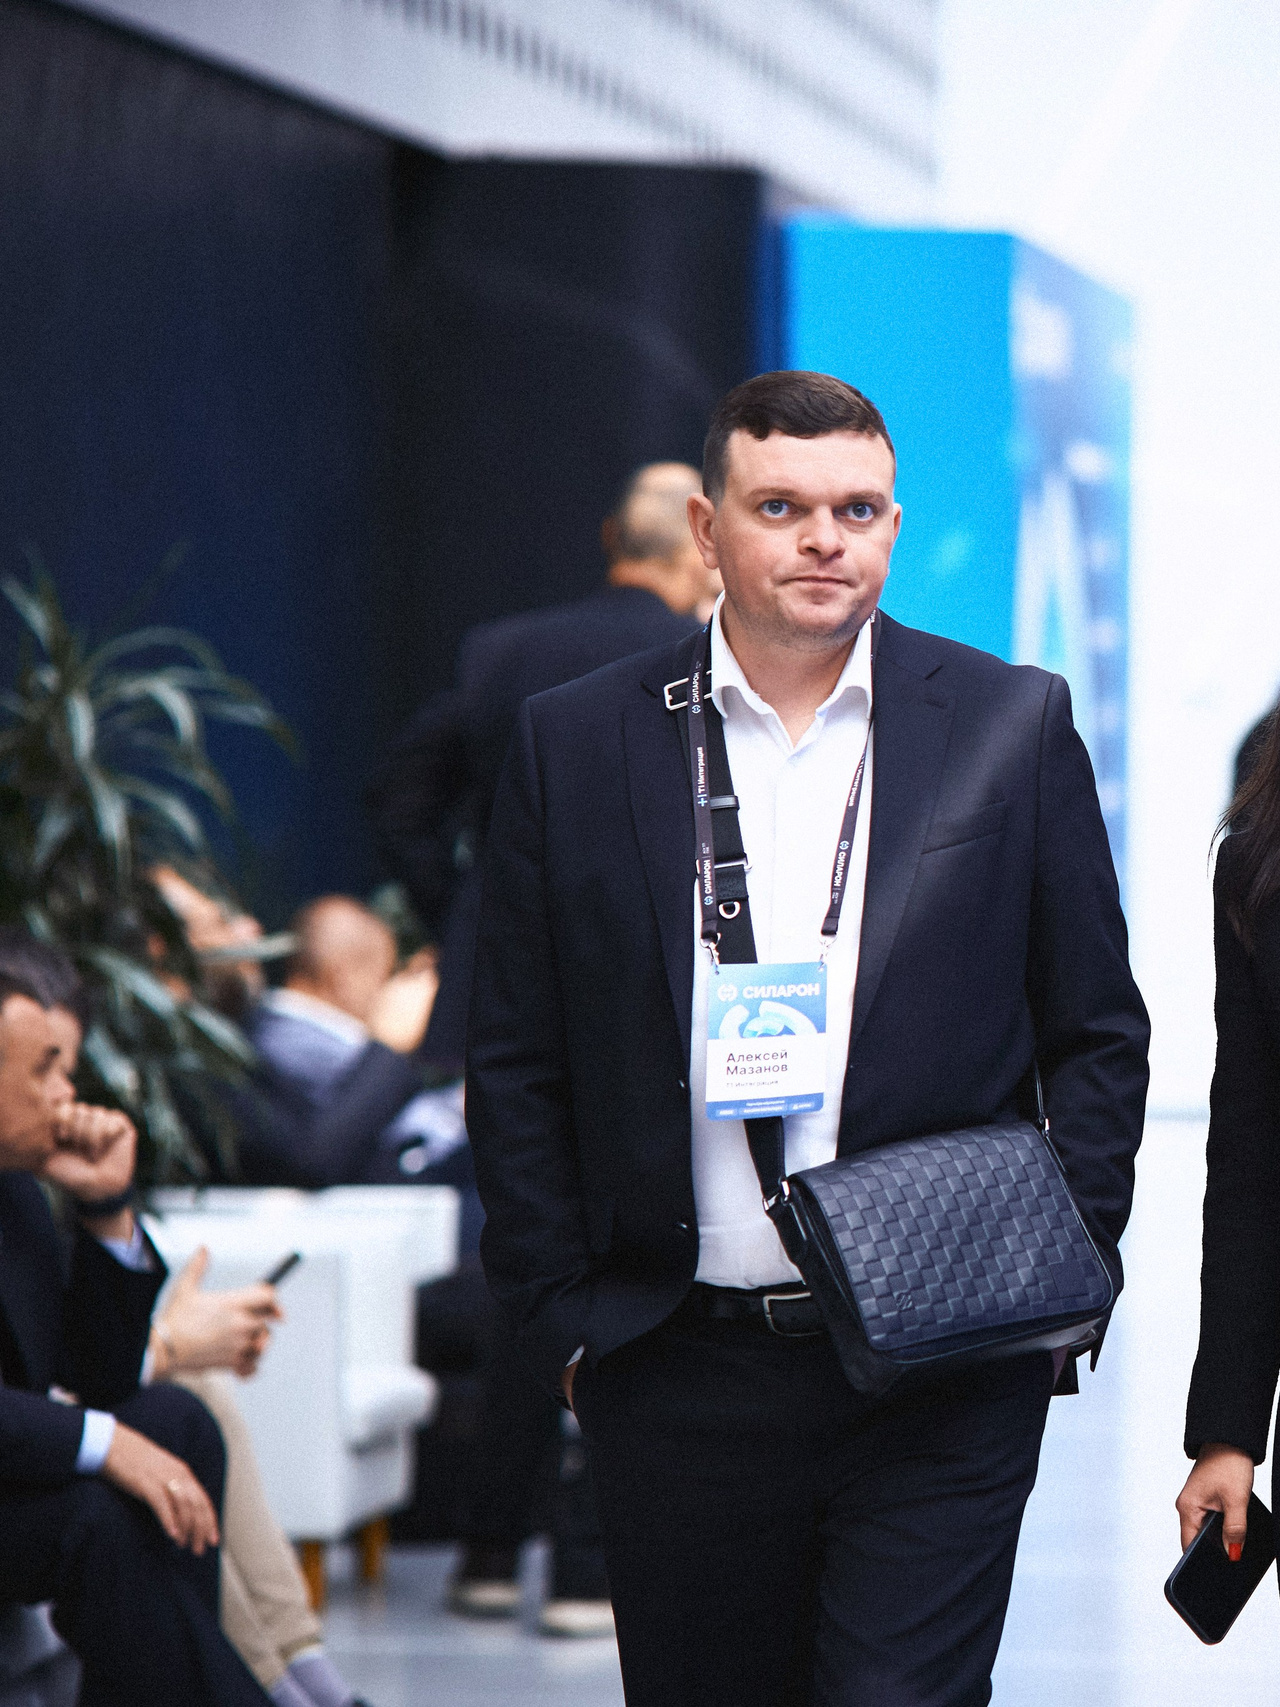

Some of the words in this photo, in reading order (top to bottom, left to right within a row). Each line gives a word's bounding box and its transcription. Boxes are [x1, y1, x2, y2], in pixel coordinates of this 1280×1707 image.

[692, 671, 700, 703] СИЛАРОН
[696, 746, 706, 785] Интеграция
[703, 860, 713, 895] СИЛАРОН
[833, 851, 847, 887] СИЛАРОН
[742, 983, 820, 999] СИЛАРОН
[726, 1049, 788, 1063] Алексей
[726, 1065, 788, 1076] Мазанов
